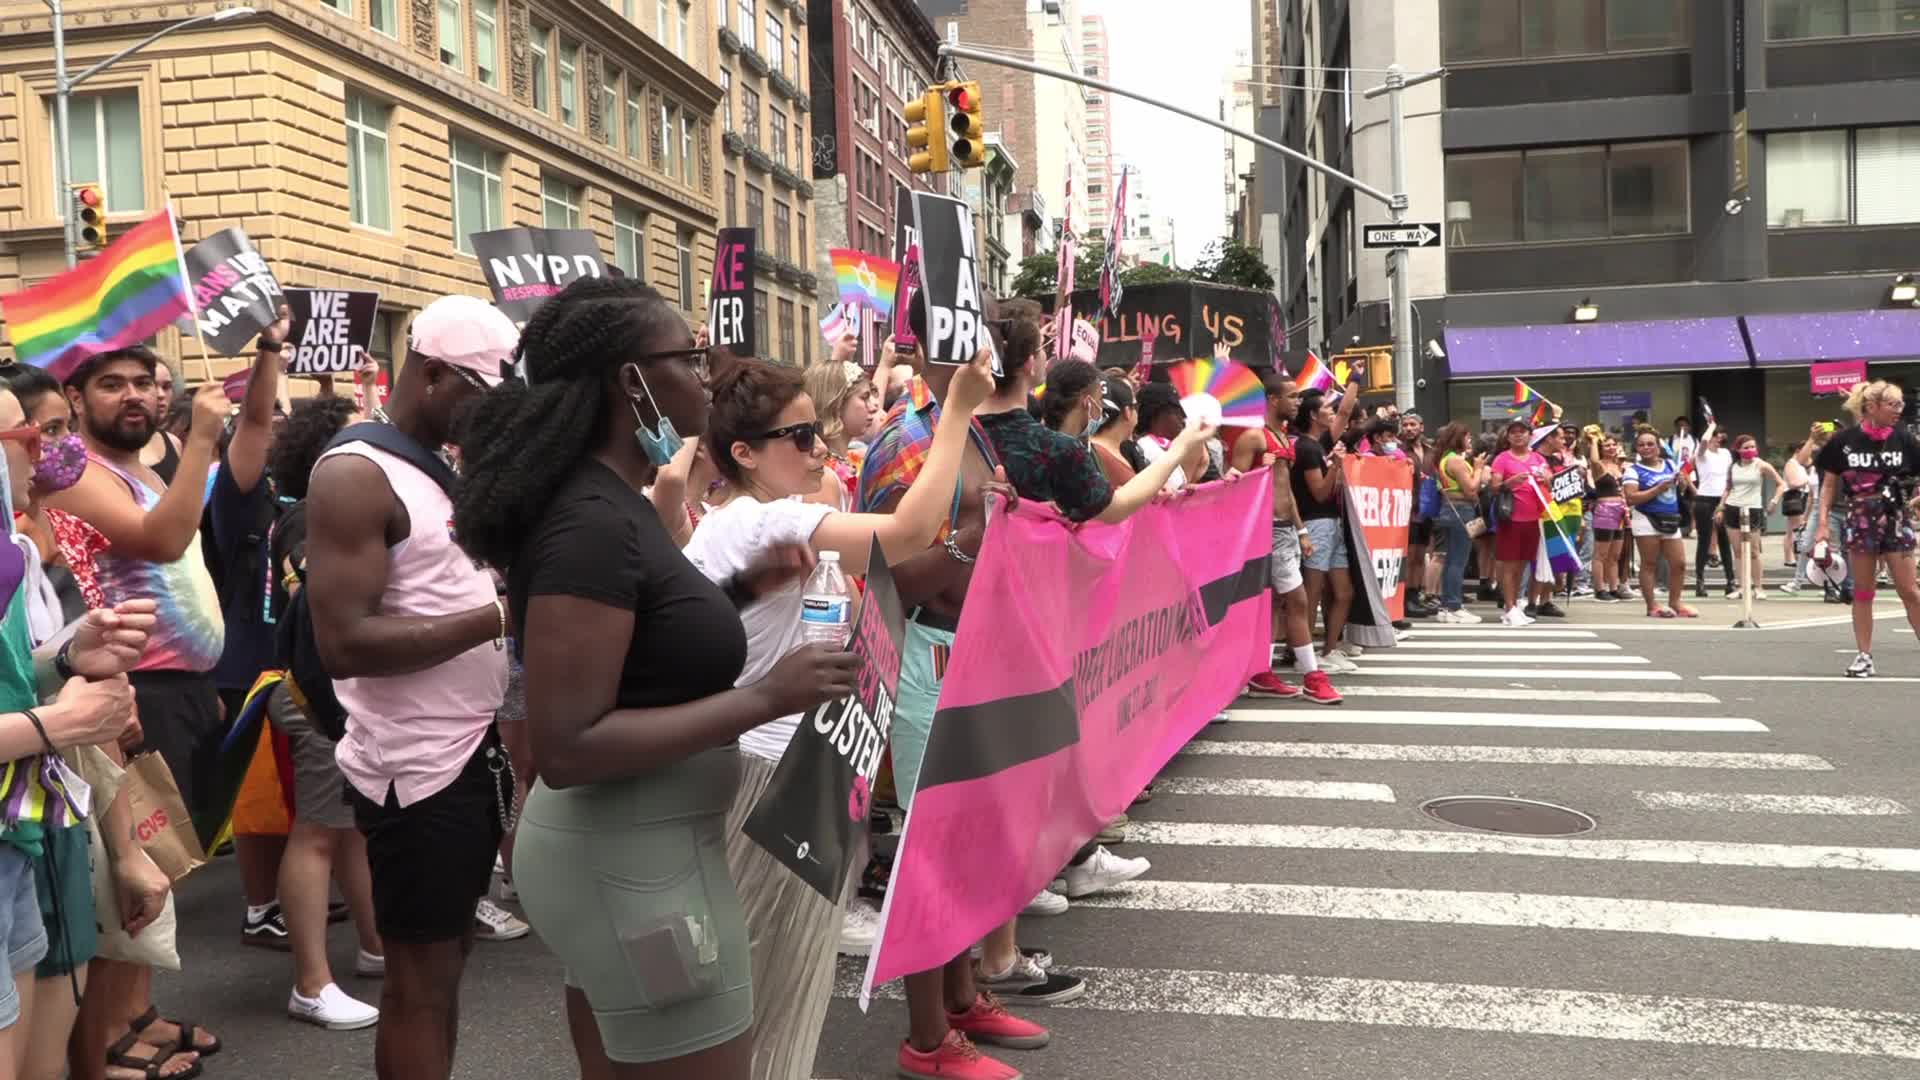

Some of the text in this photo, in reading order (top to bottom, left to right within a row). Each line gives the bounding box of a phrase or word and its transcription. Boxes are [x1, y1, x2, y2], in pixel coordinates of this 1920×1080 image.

[1374, 230, 1430, 241] ONE WAY
[489, 253, 601, 288] NYPD
[309, 290, 350, 318] WE
[302, 318, 351, 346] ARE
[136, 808, 169, 841] CVS
